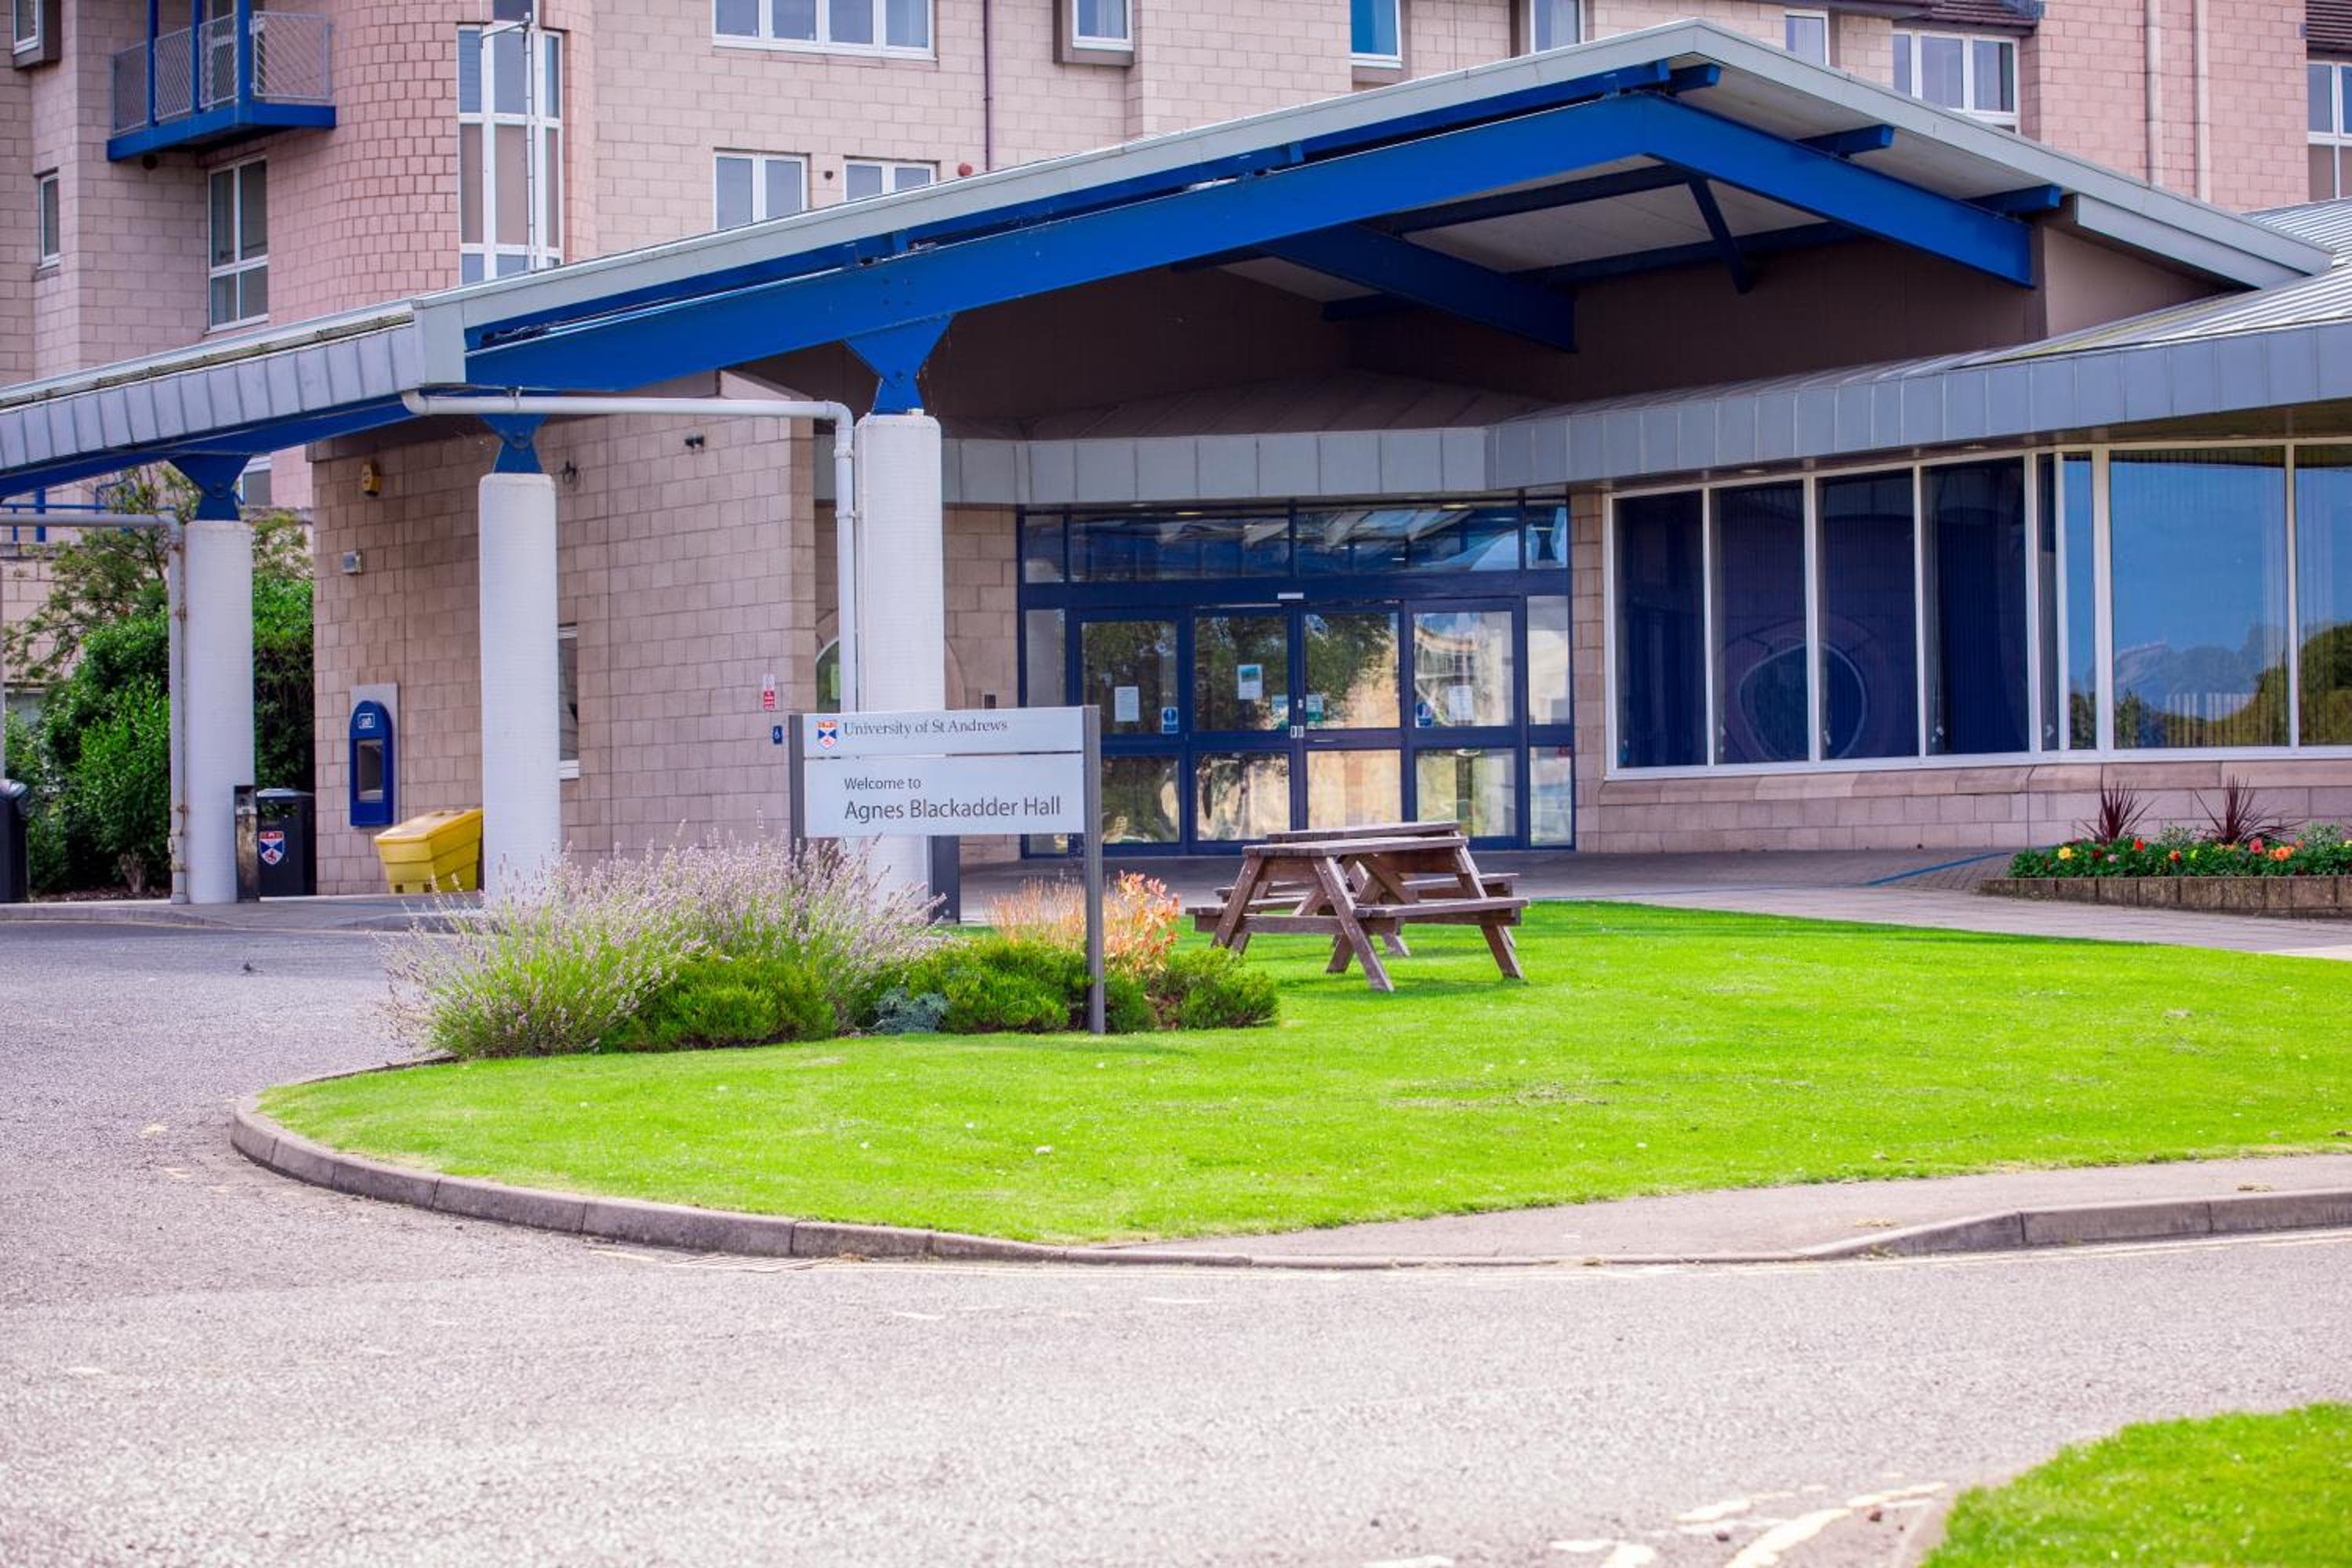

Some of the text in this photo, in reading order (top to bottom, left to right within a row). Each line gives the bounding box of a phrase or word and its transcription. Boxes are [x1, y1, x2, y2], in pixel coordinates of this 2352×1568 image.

[844, 718, 1008, 739] University of St Andrews
[844, 776, 922, 790] Welcome to
[844, 795, 1061, 824] Agnes Blackadder Hall
